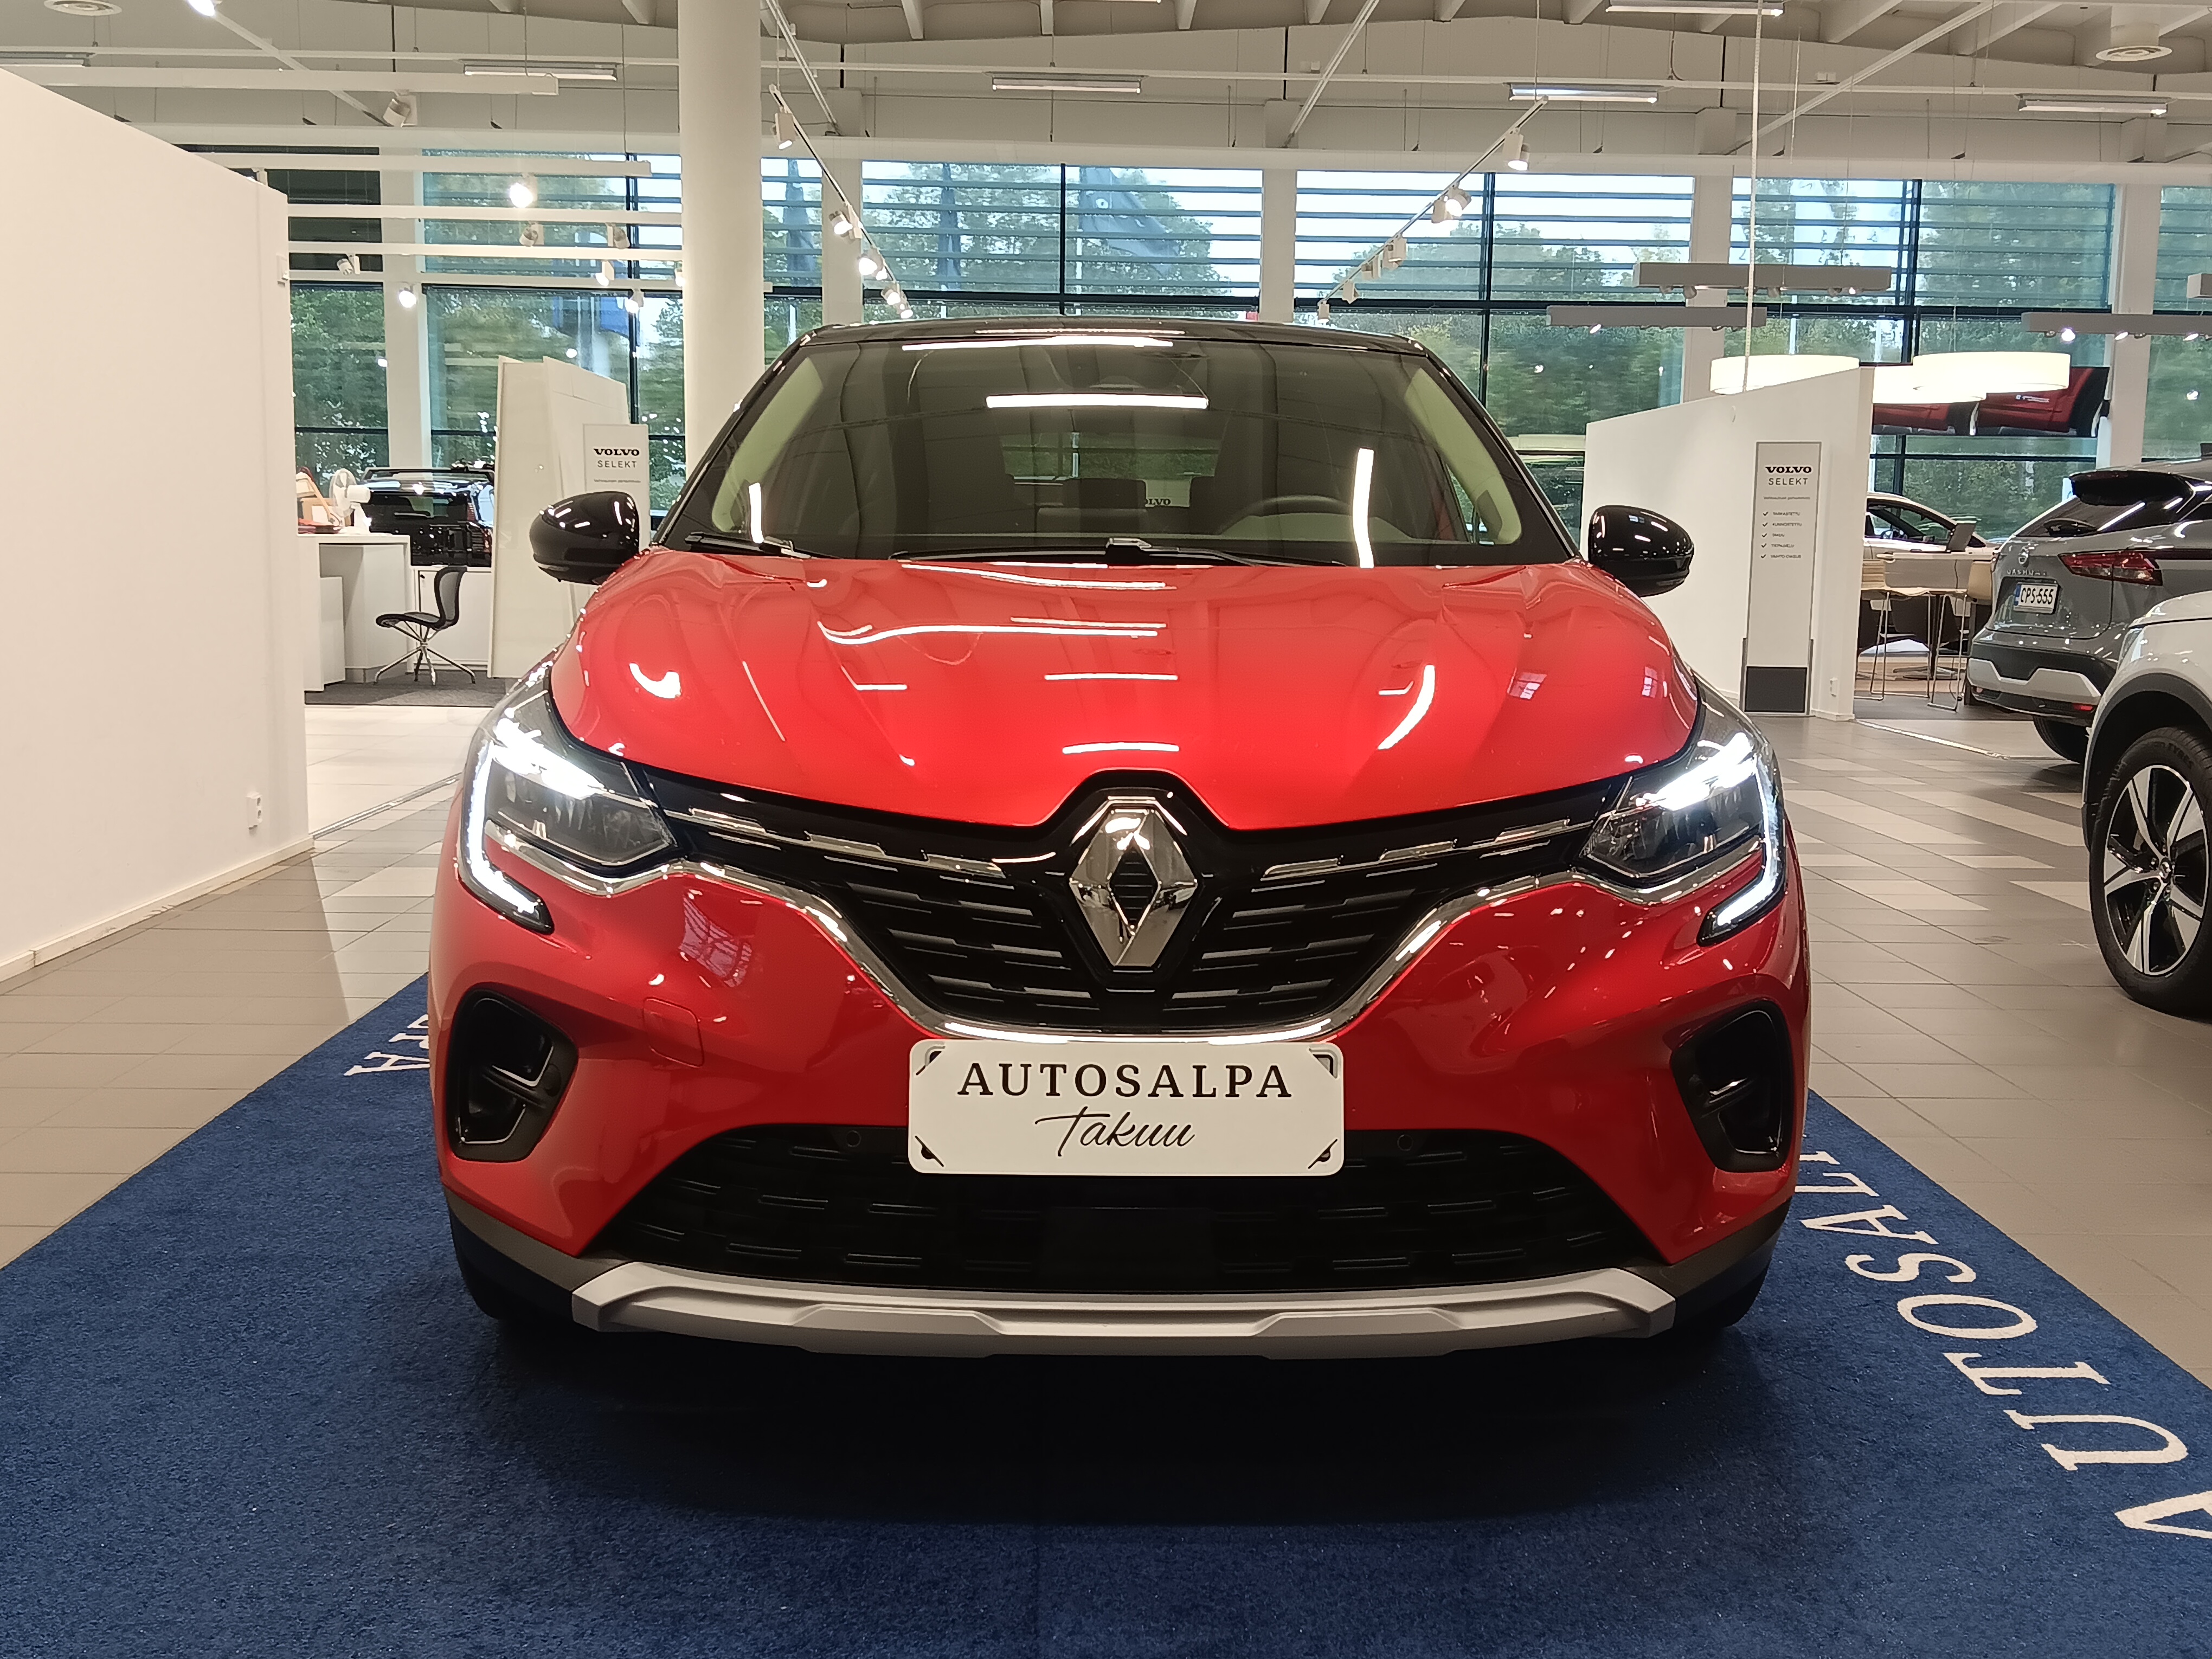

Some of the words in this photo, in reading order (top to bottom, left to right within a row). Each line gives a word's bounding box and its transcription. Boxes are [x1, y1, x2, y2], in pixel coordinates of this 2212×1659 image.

[2021, 588, 2054, 605] CPS-555
[957, 1062, 1292, 1098] AUTOSALPA
[1035, 1106, 1195, 1157] Takuu
